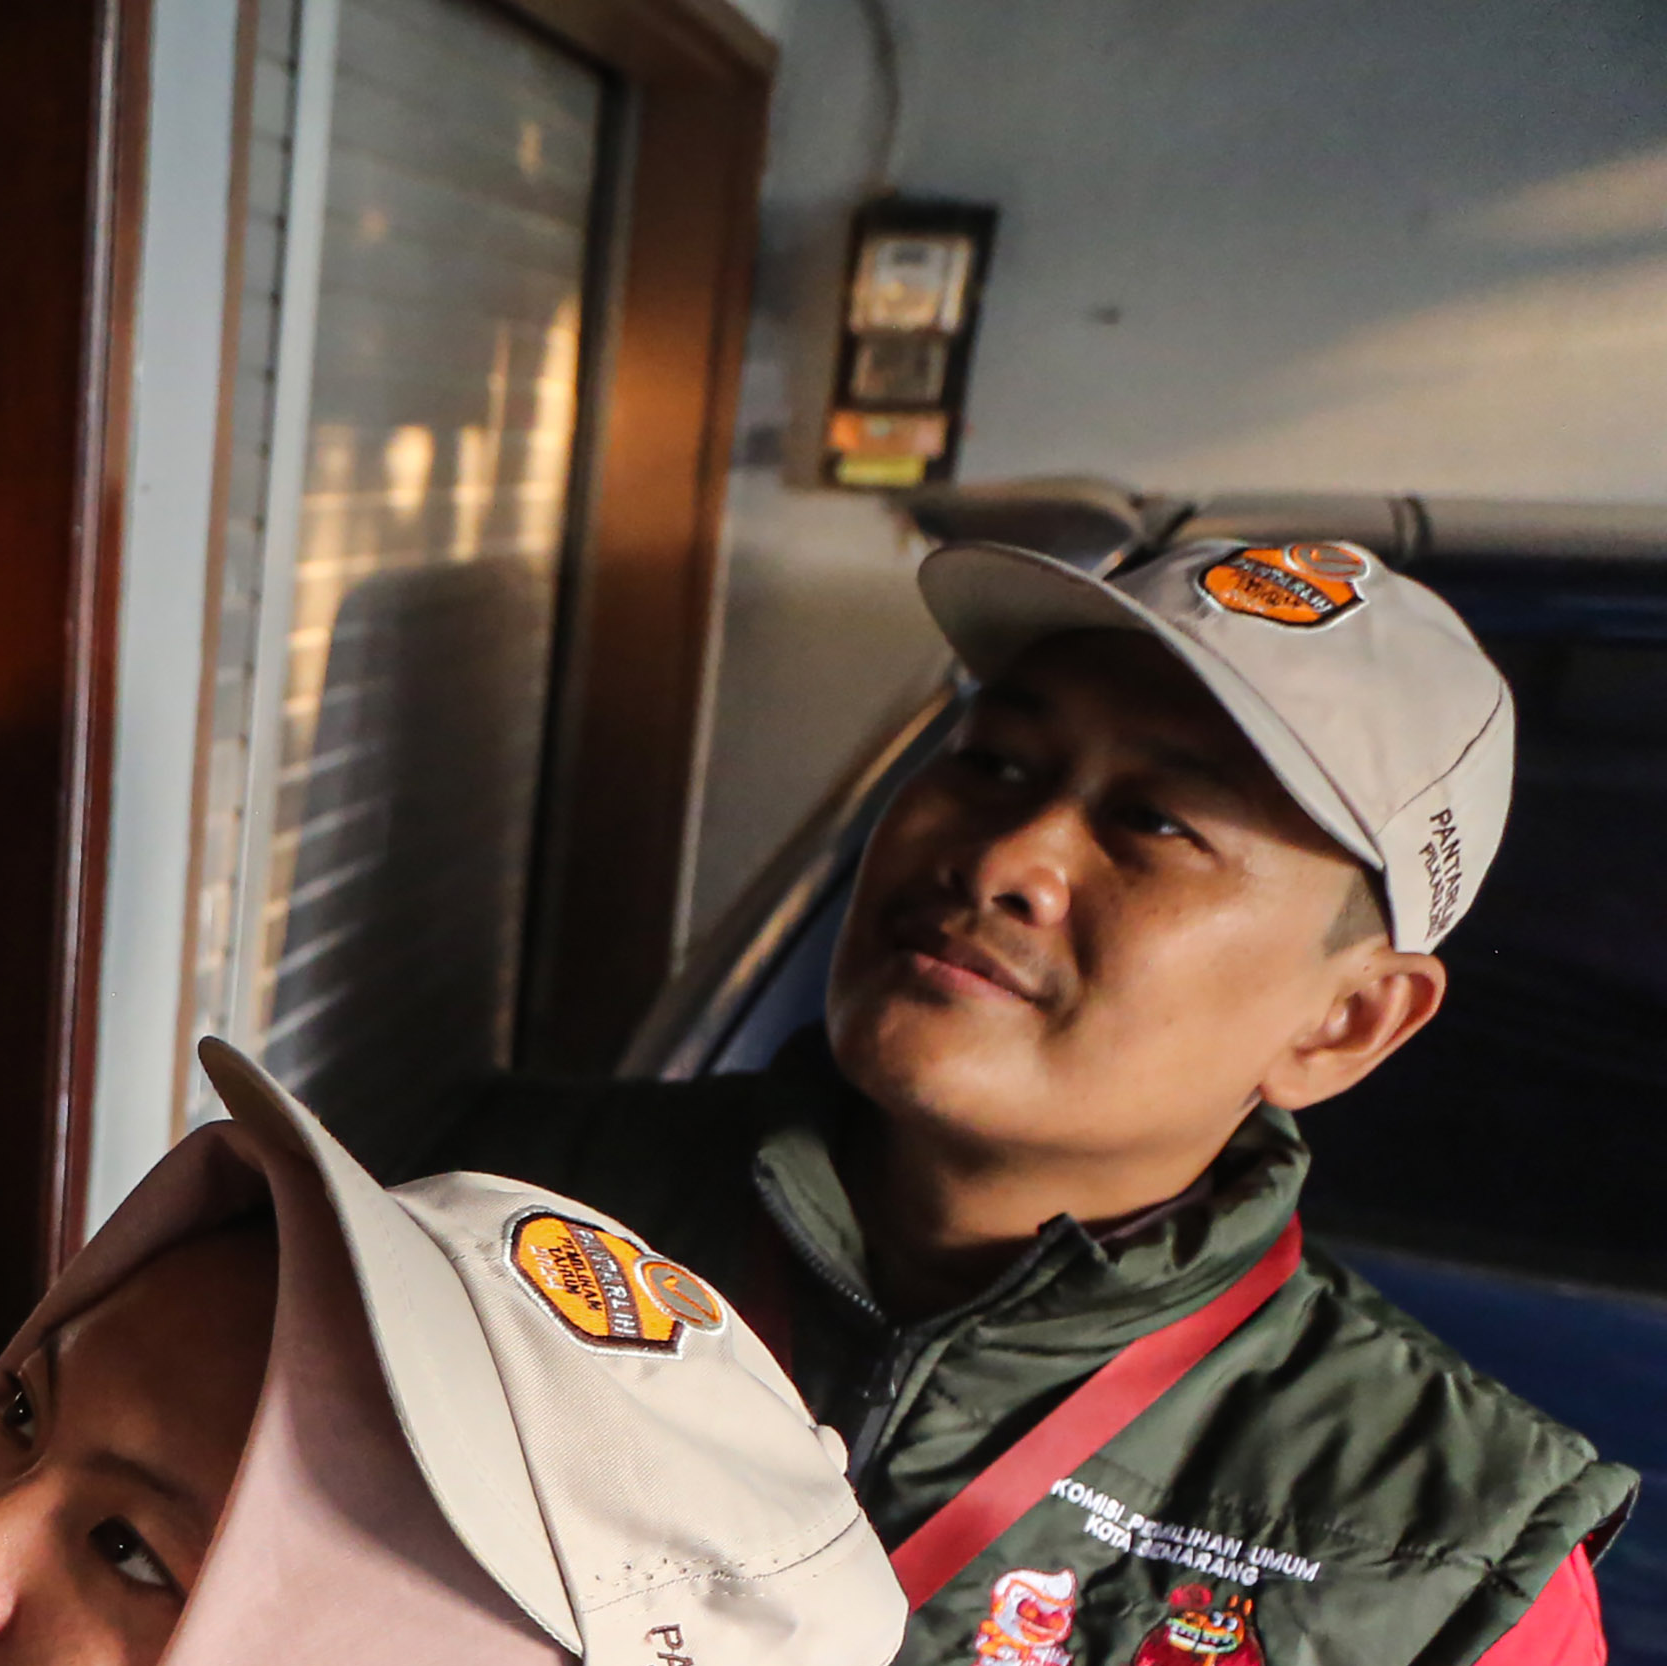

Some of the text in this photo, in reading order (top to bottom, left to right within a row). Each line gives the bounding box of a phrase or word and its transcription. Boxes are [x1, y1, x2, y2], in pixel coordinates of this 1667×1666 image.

[549, 1247, 581, 1295] TAHUN
[578, 1230, 637, 1335] PANTARLIH
[1051, 1477, 1322, 1582] KOMISI PEMILIHAN UMUM
[1083, 1514, 1259, 1586] KOTA SEMARANG
